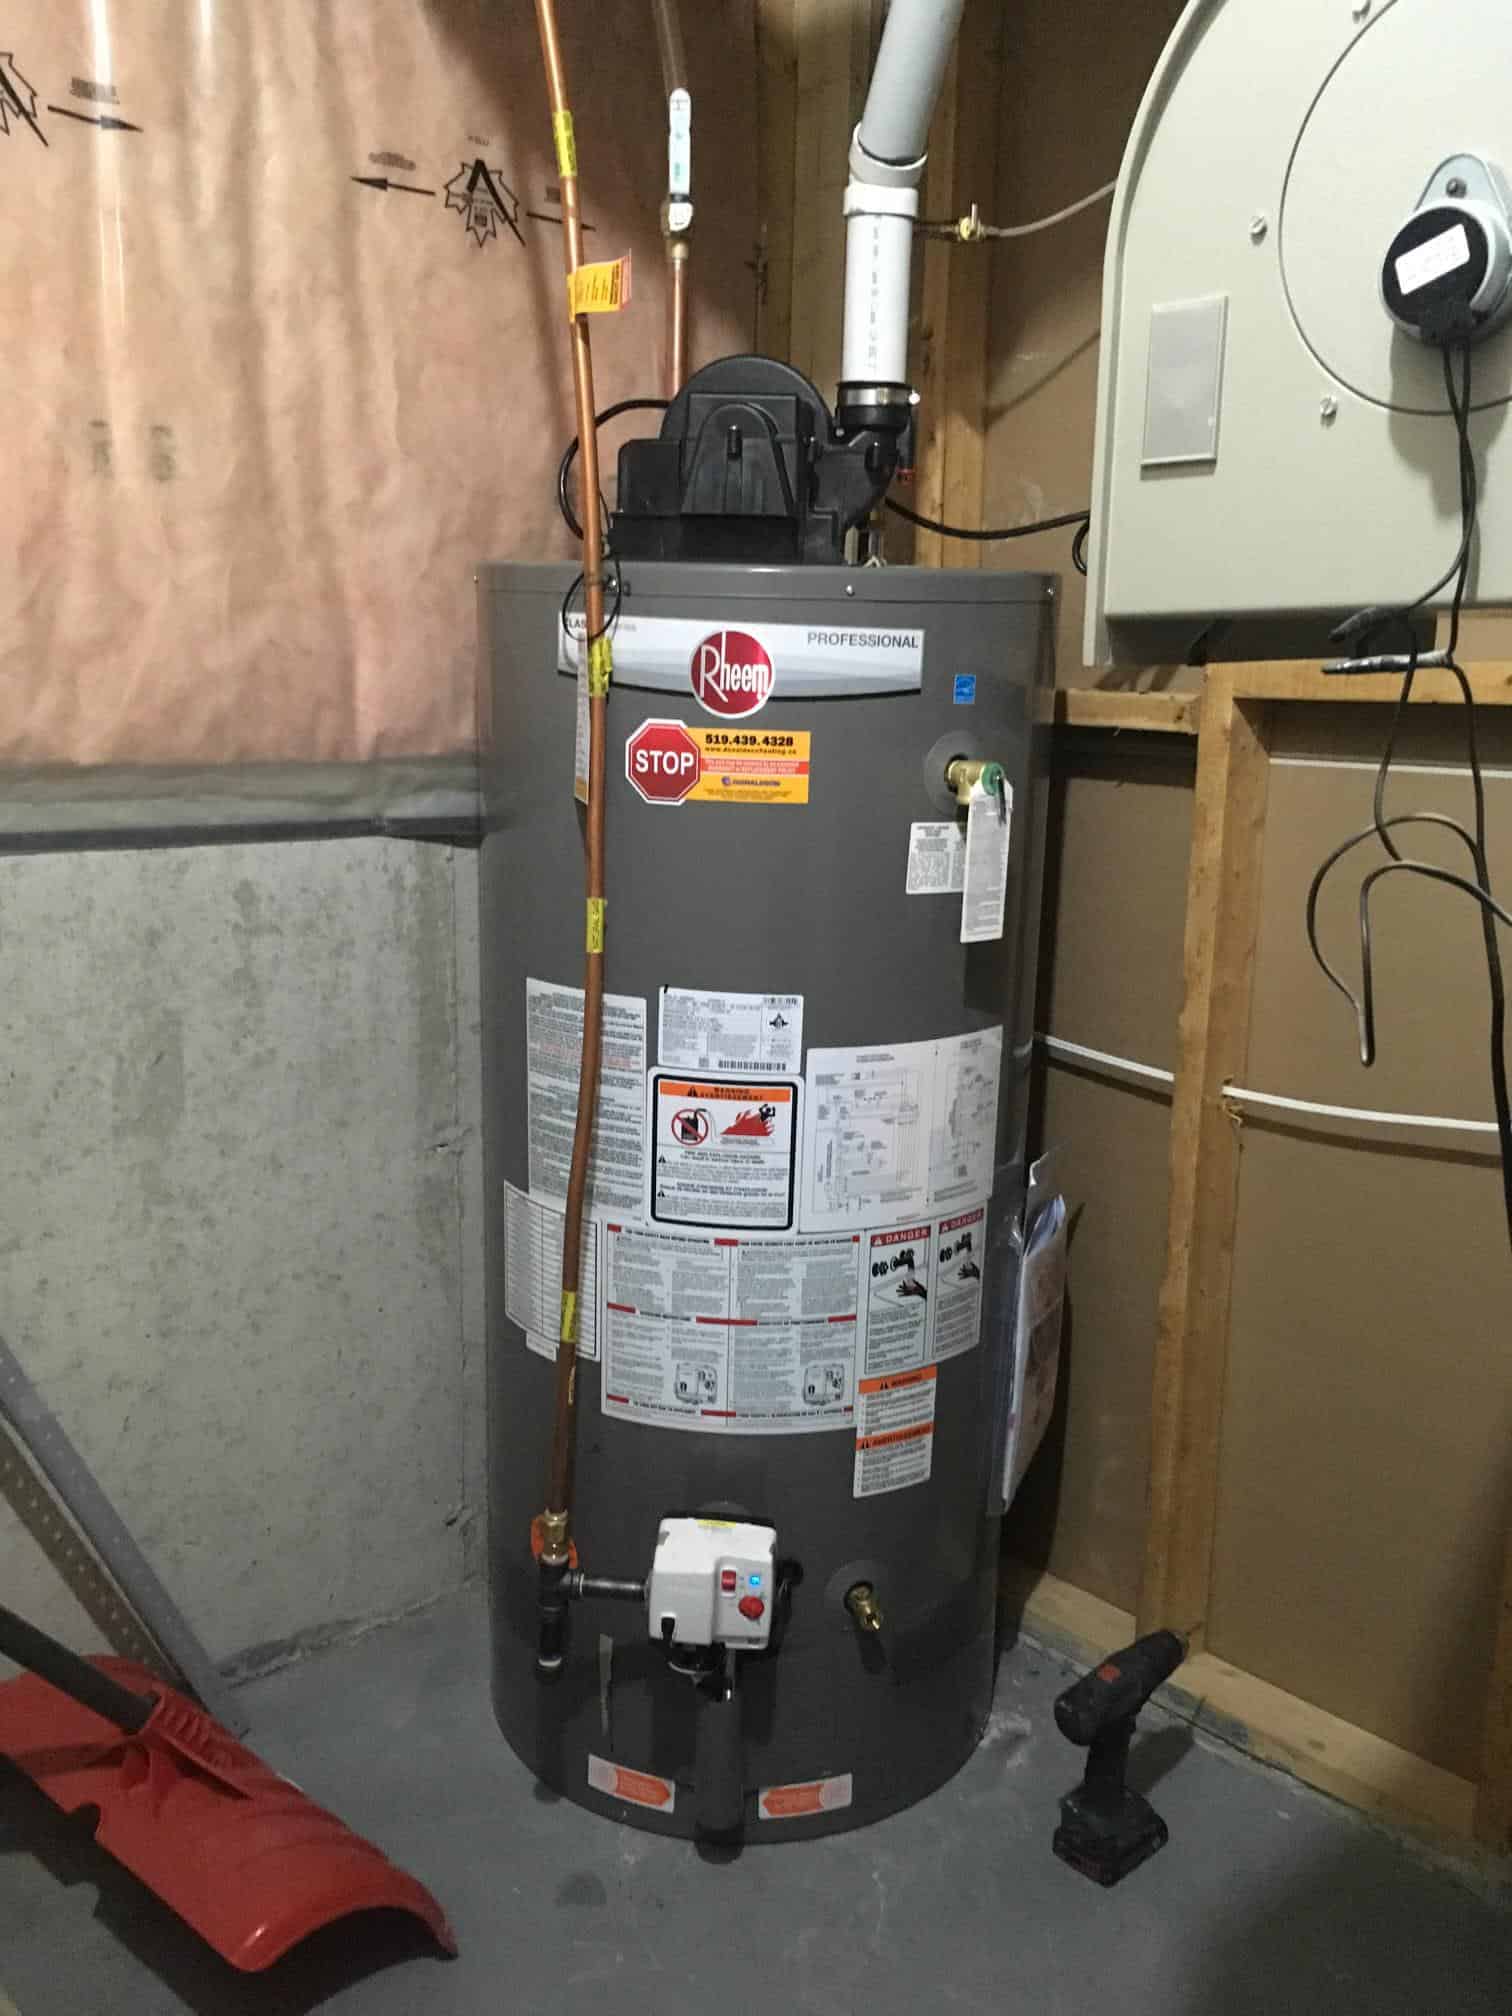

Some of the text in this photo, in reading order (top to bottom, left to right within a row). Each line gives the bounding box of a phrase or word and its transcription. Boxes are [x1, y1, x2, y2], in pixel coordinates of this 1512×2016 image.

[807, 631, 919, 649] PROFESSIONAL
[700, 631, 769, 702] Rheem
[705, 733, 794, 747] 519.439.4328
[635, 749, 695, 776] STOP
[886, 1227, 928, 1243] DANGER
